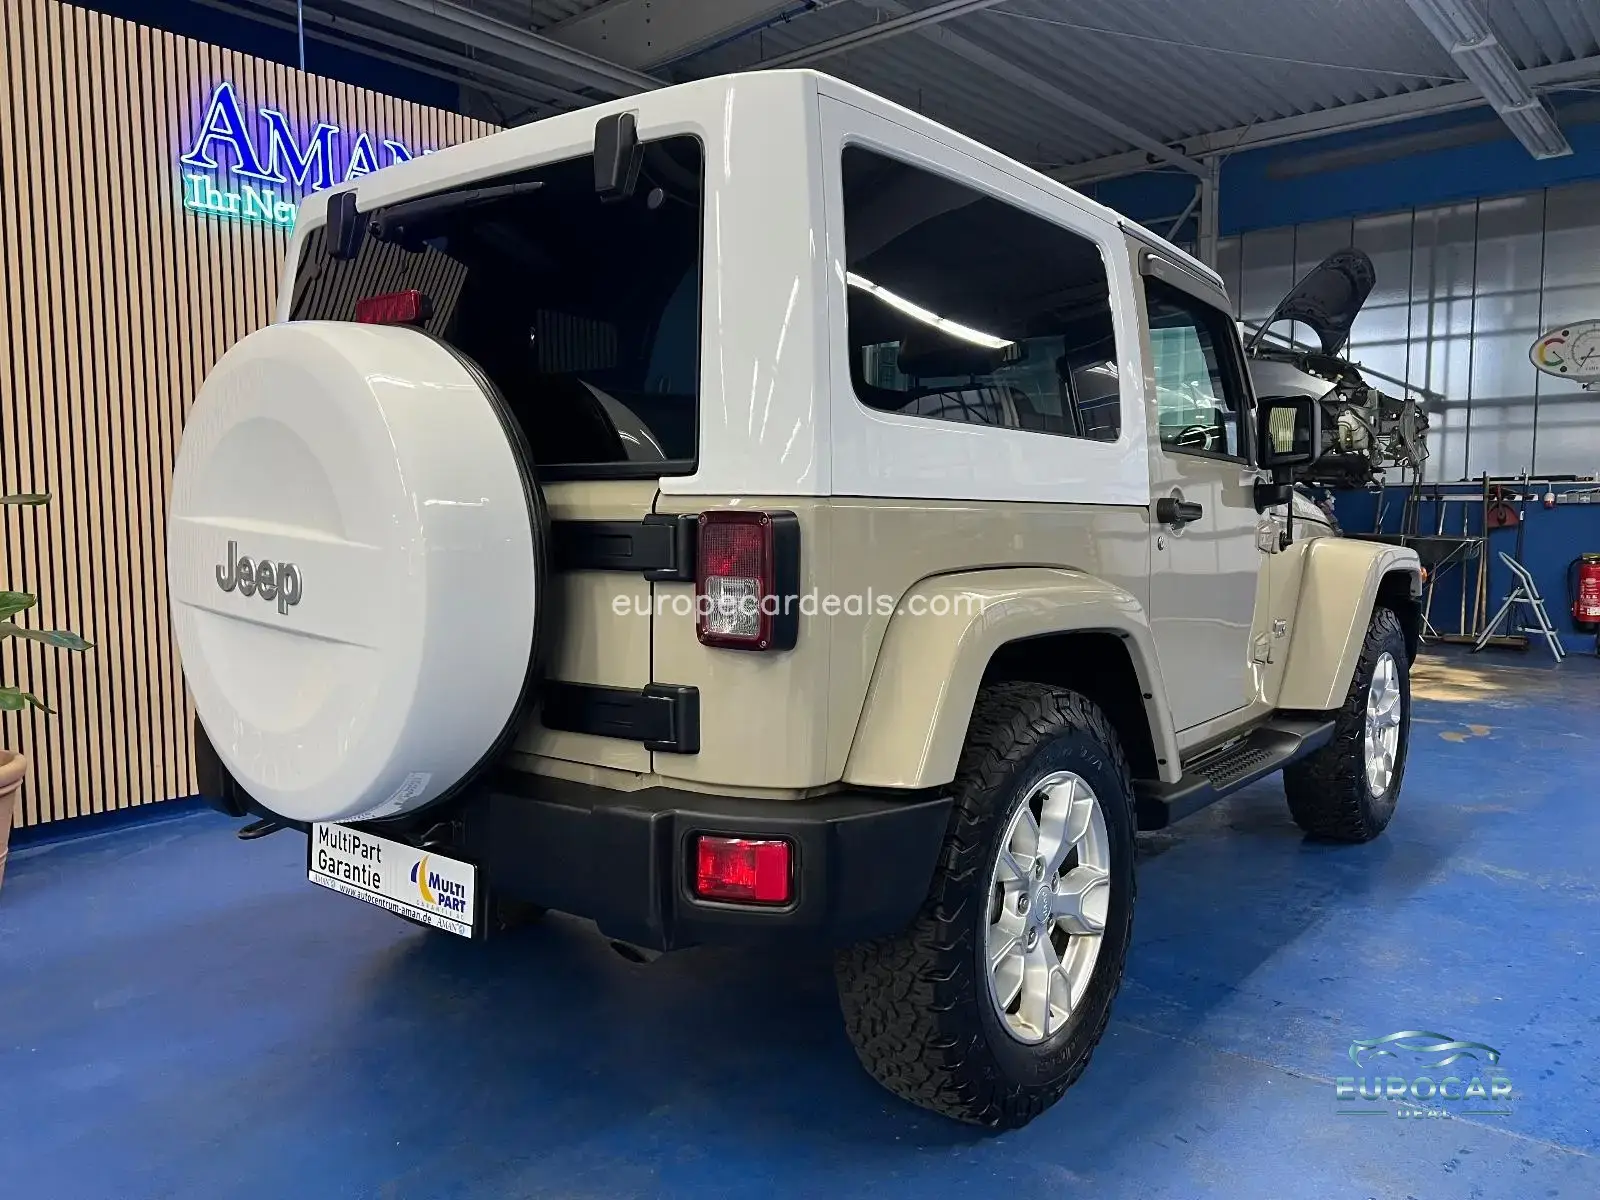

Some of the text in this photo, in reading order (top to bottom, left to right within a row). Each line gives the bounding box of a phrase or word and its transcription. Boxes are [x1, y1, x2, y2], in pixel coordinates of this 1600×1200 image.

[181, 82, 434, 190] AMA
[187, 174, 241, 213] Ihr
[215, 540, 303, 616] Jeep
[319, 825, 382, 864] MultiPart
[318, 848, 381, 889] Garantie
[428, 871, 465, 899] MULTI
[339, 884, 432, 924] www.autocentrum-aman.de
[438, 892, 466, 913] PART
